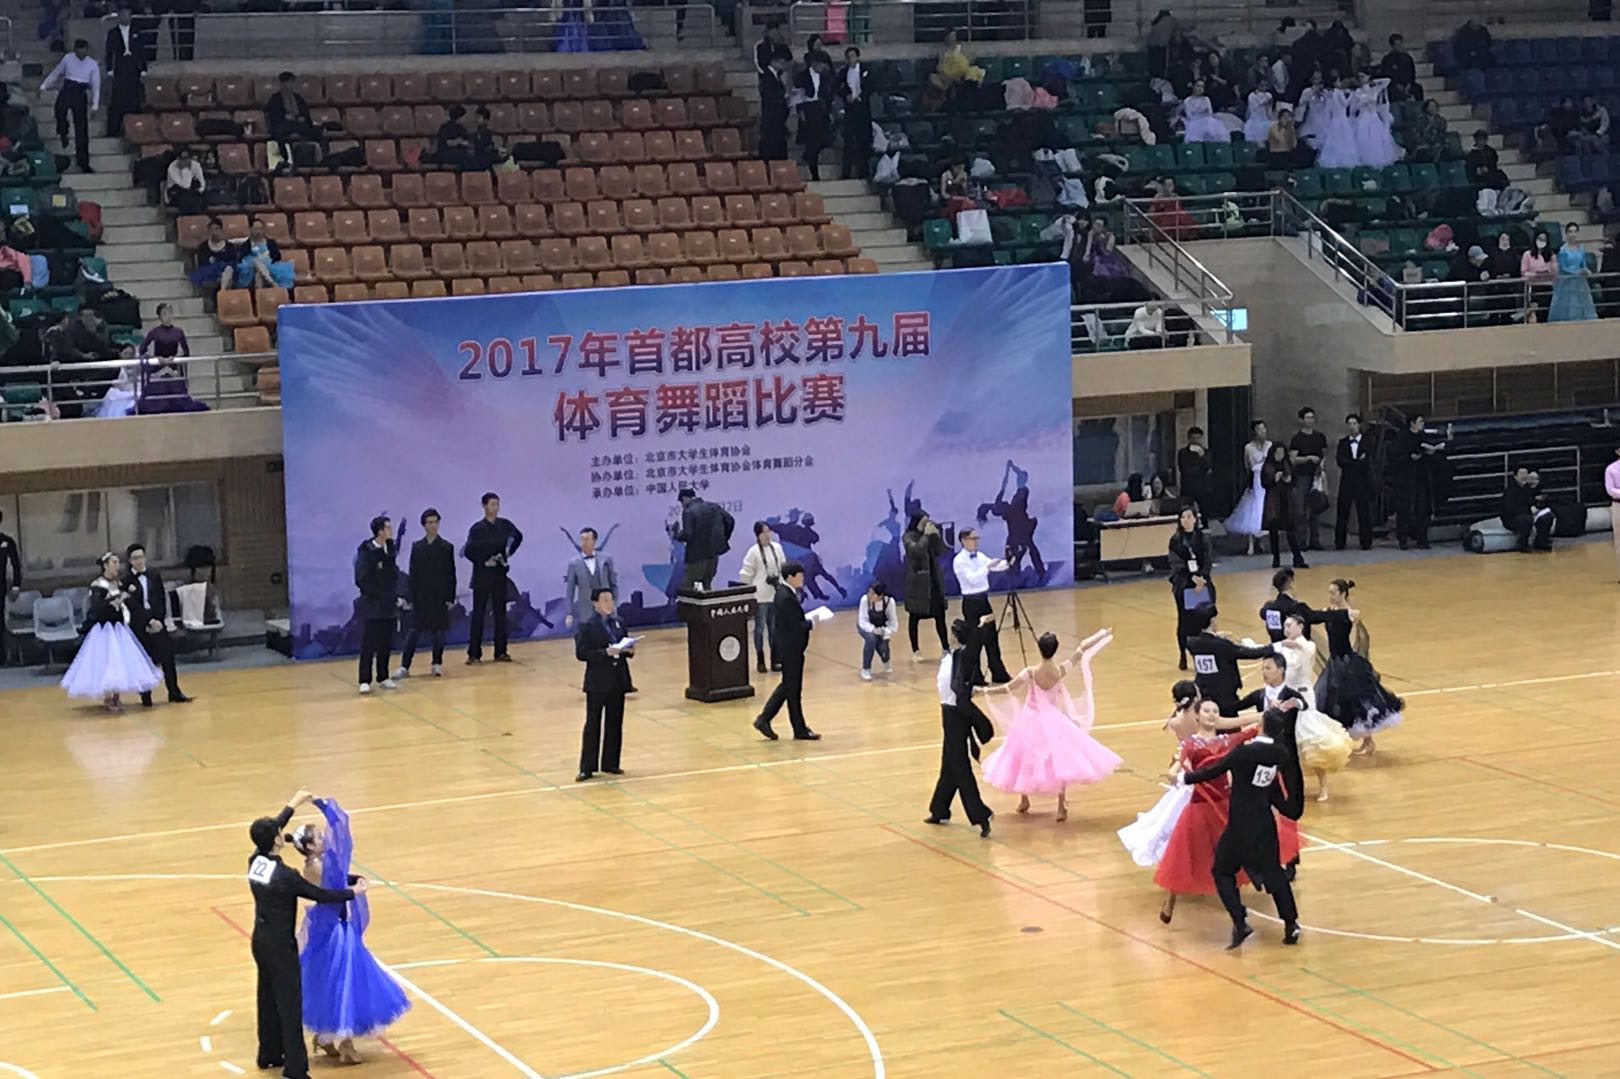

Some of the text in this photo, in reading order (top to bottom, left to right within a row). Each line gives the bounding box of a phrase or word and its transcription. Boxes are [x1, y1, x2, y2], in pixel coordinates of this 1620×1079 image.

[457, 311, 931, 381] 2017年首都高校第九届
[553, 373, 846, 442] 体育舞蹈比赛
[1197, 658, 1214, 672] 157
[253, 860, 268, 877] 22
